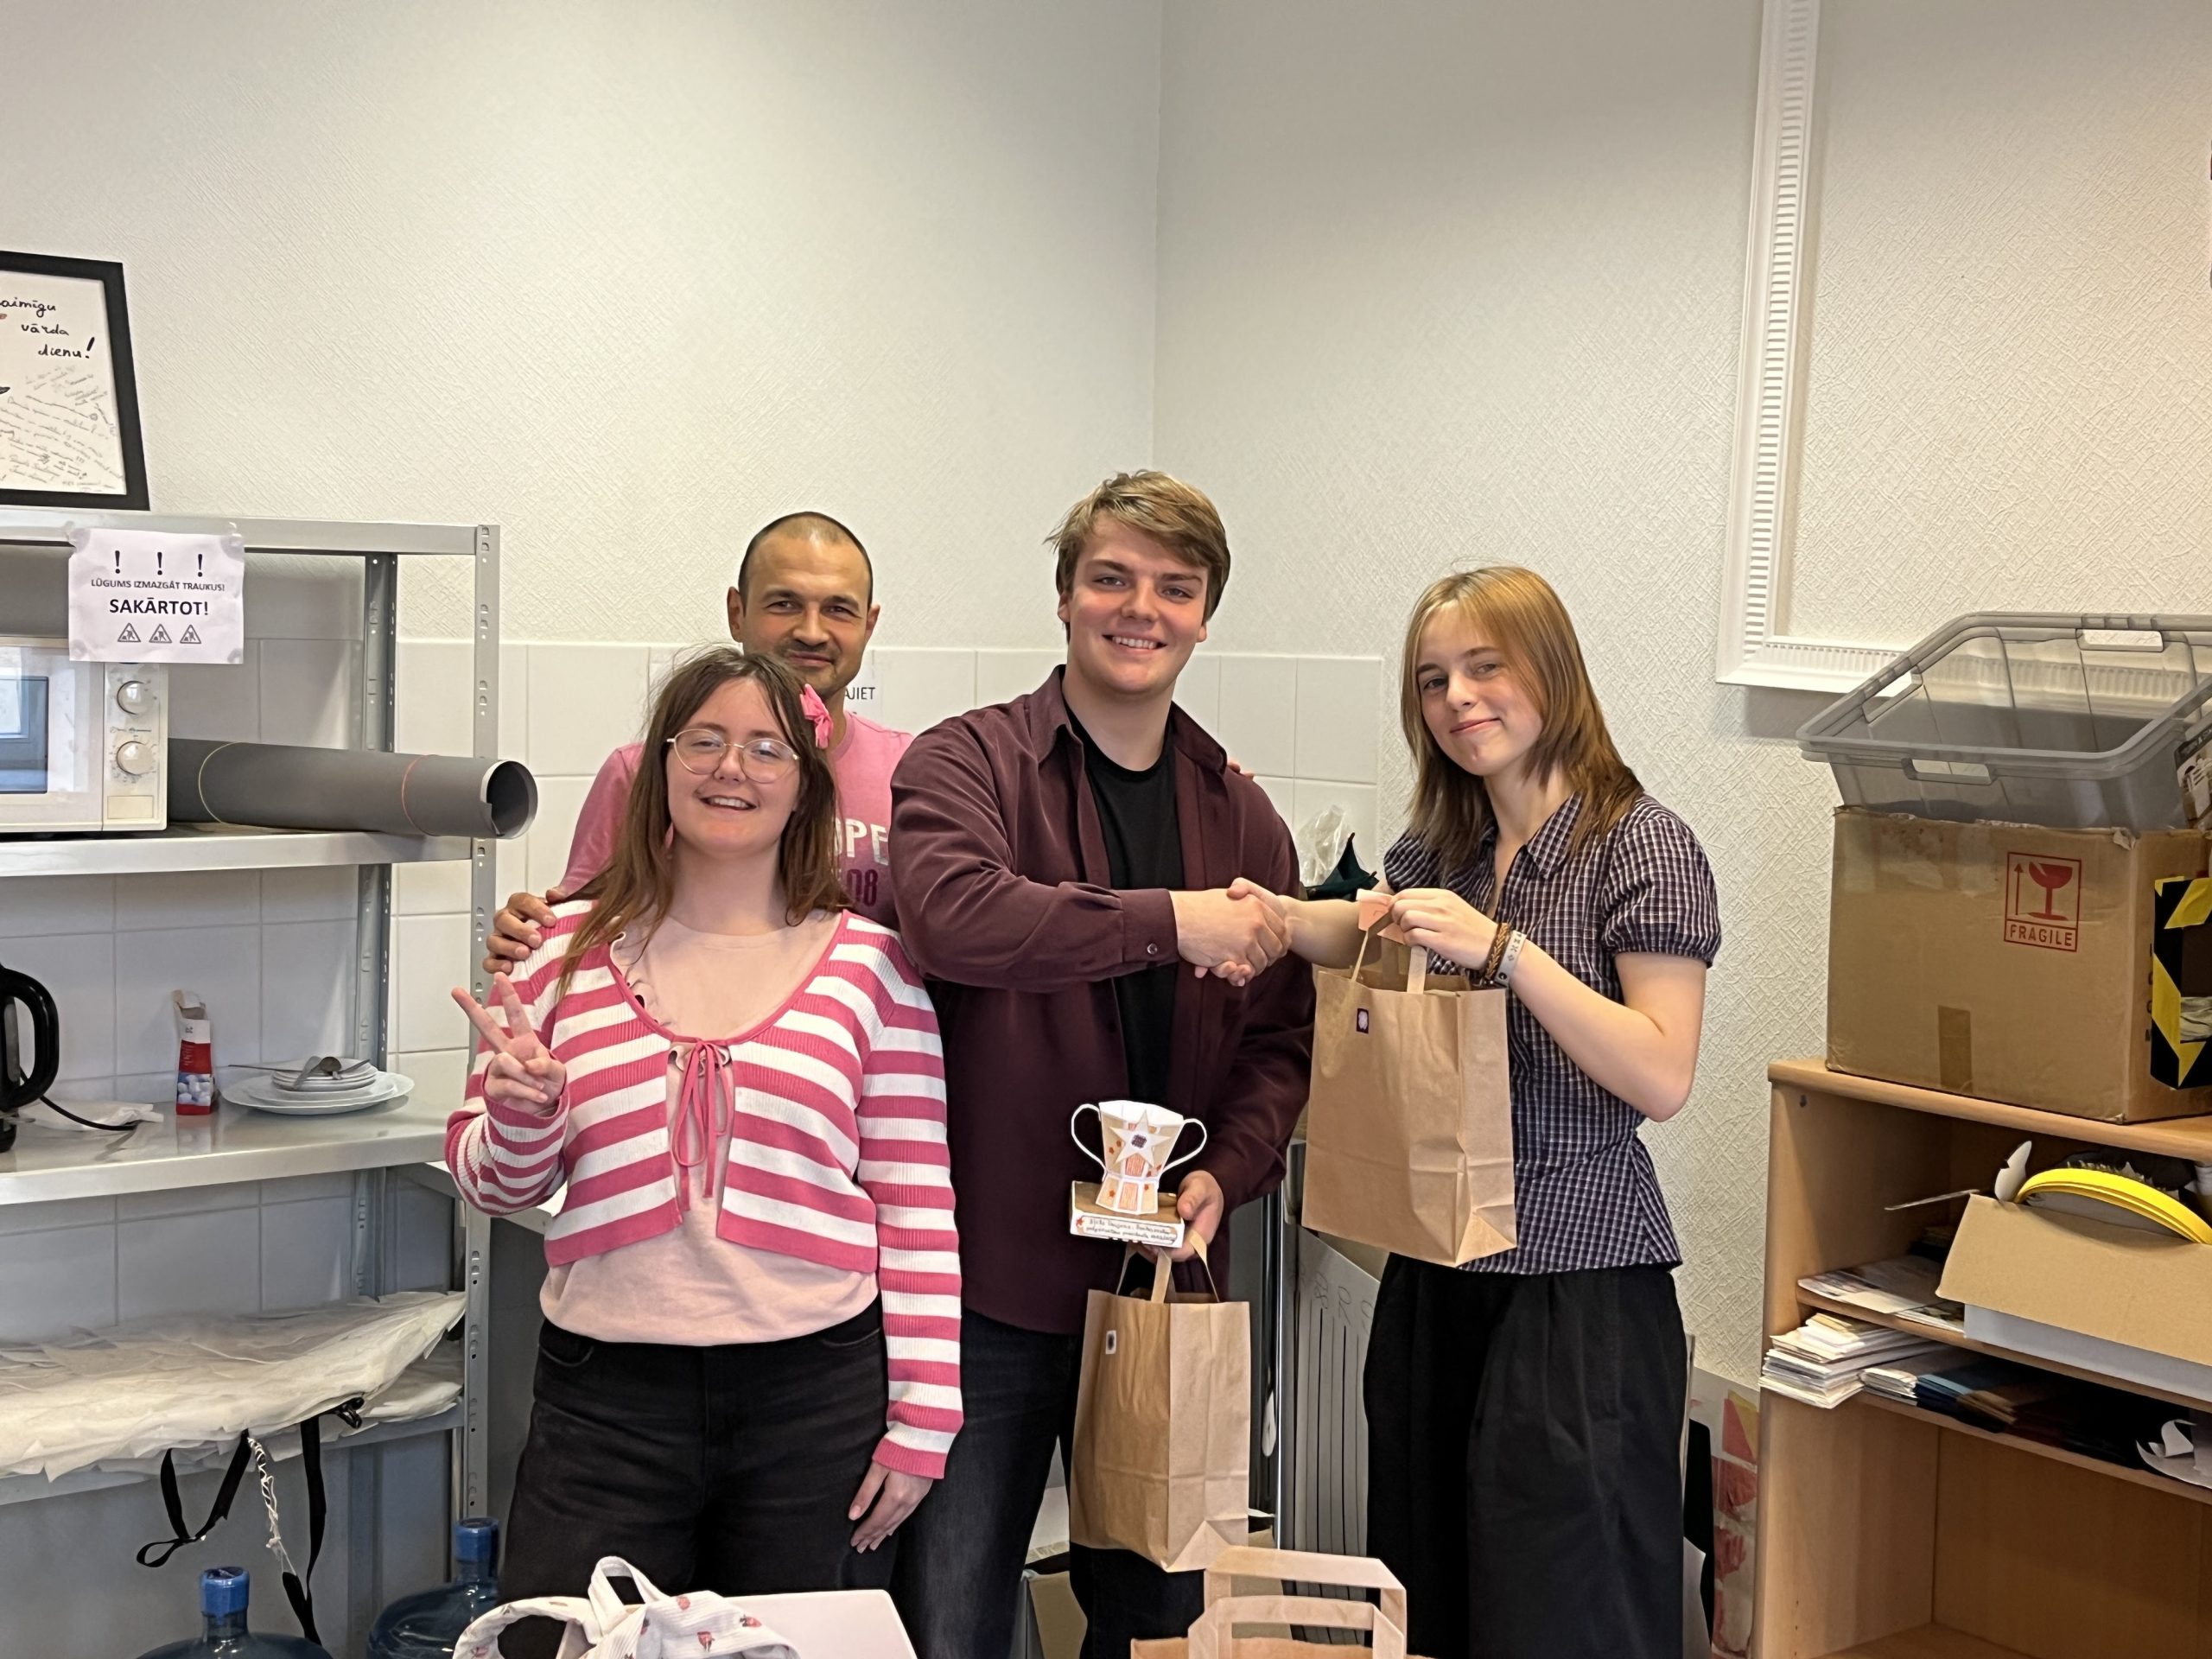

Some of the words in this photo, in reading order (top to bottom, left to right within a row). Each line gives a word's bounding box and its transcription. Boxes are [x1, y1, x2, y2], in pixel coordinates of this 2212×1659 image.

[0, 296, 56, 318] aimīgu
[21, 323, 69, 336] vārda
[38, 336, 95, 359] dienu!
[109, 597, 208, 616] SAKĀRTOT!
[2010, 924, 2073, 947] FRAGILE
